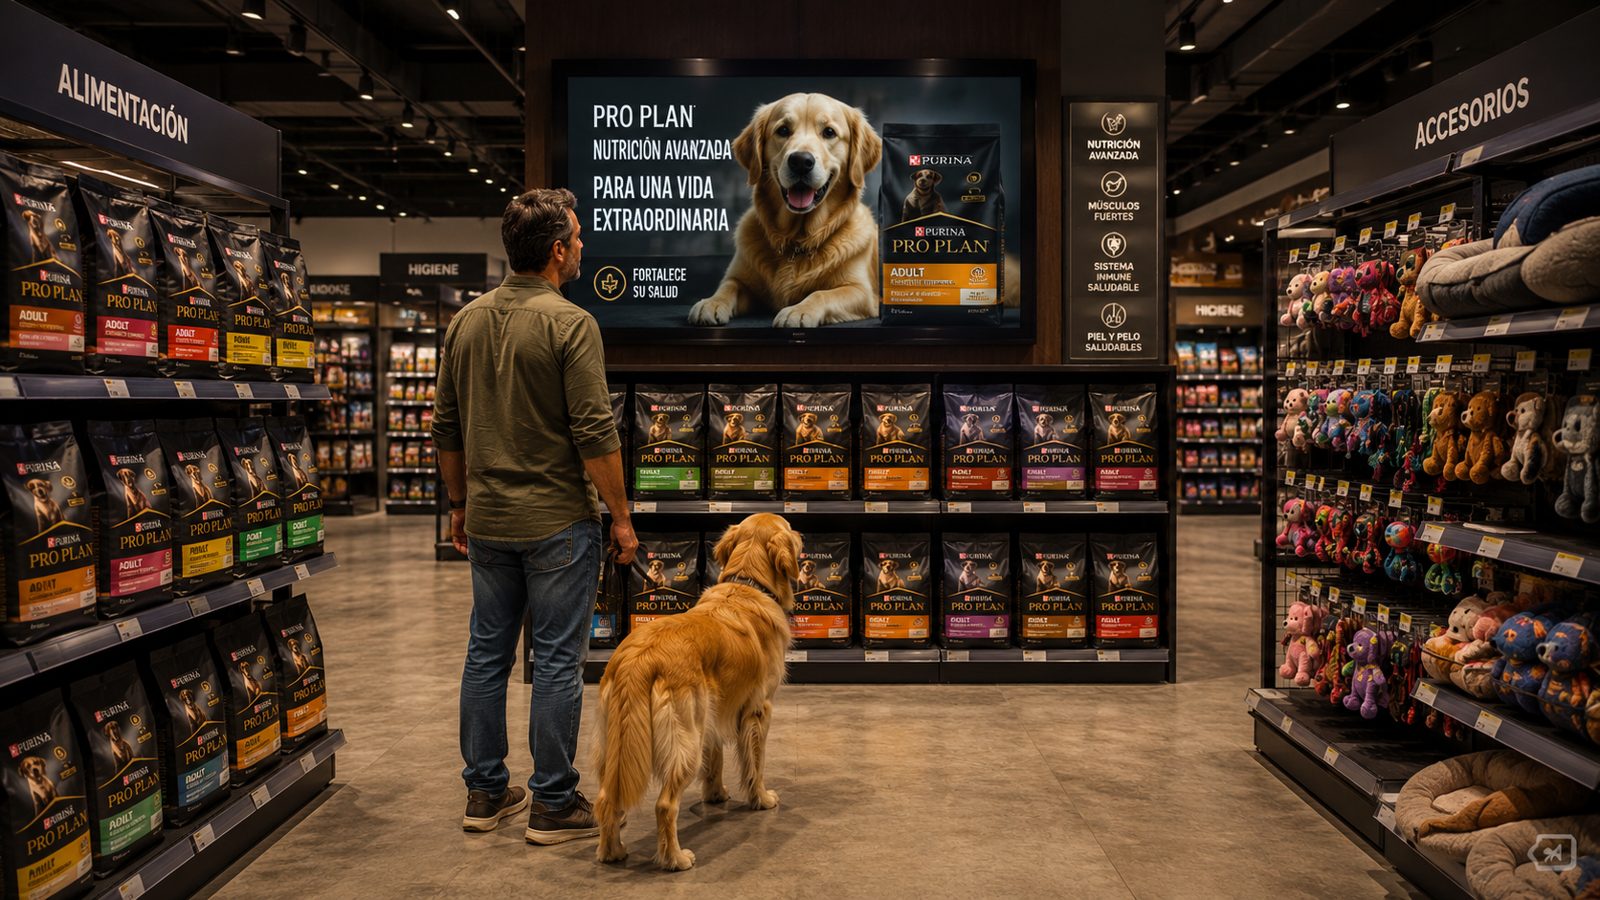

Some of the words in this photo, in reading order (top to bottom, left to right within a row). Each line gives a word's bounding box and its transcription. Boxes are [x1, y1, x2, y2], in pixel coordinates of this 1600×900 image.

[58, 63, 188, 144] ALIMENTACIÓN
[593, 104, 633, 128] PRO
[640, 104, 693, 128] PLAN
[1414, 76, 1529, 150] ACCESORIOS
[1087, 138, 1141, 149] NUTRICIÓN
[922, 156, 972, 165] PURINA
[1089, 151, 1139, 160] AVANZADA
[593, 175, 635, 199] PARA
[640, 175, 673, 199] UNA
[676, 175, 714, 199] VIDA
[1088, 200, 1140, 210] MÚSCULOS
[593, 208, 730, 232] EXTRAORDINARIA
[1094, 212, 1134, 220] FUERTES
[926, 227, 966, 236] PURINA
[892, 239, 930, 254] PRO
[934, 239, 989, 254] PLAN
[408, 263, 459, 276] HIGIENE
[890, 267, 925, 277] ADULT
[1094, 262, 1134, 271] SISTEMA
[633, 268, 687, 282] FORTALECE
[1096, 272, 1132, 282] INMUNE
[21, 280, 51, 298] PRO
[53, 285, 83, 303] PLAN
[633, 286, 646, 298] SU
[648, 286, 678, 298] SALUD
[1087, 283, 1140, 292] SALUDABLE
[106, 294, 131, 310] PRO
[20, 310, 48, 322] ADULT
[176, 304, 196, 319] PRO
[234, 314, 252, 327] PRO
[1088, 332, 1106, 341] PIEL
[1108, 332, 1115, 341] Y
[1117, 332, 1140, 341] PELO
[1085, 343, 1142, 352] SALUDABLES
[641, 454, 662, 463] PRO
[665, 454, 696, 463] PLAN
[716, 454, 737, 463] PRO
[740, 454, 770, 463] PLAN
[790, 454, 812, 463] PRO
[814, 454, 844, 463] PLAN
[870, 454, 892, 463] PRO
[894, 454, 924, 463] PLAN
[952, 454, 974, 463] PRO
[977, 454, 1007, 463] PLAN
[1028, 454, 1049, 463] PRO
[1052, 454, 1081, 463] PLAN
[1100, 454, 1122, 463] PRO
[1126, 454, 1153, 463] PLAN
[293, 500, 309, 514] PRO
[247, 512, 264, 524] PRO
[190, 522, 211, 537] PRO
[120, 534, 145, 550] PRO
[146, 528, 172, 545] PLAN
[30, 550, 59, 568] PRO
[61, 542, 94, 562] PLAN
[636, 602, 658, 610] PRO
[660, 602, 690, 610] PLAN
[791, 602, 811, 610] PRO
[814, 602, 844, 610] PLAN
[870, 602, 892, 610] PRO
[894, 602, 924, 610] PLAN
[952, 602, 972, 610] PRO
[976, 602, 1005, 610] PLAN
[1028, 602, 1050, 610] PRO
[1053, 602, 1082, 610] PLAN
[1100, 602, 1122, 610] PRO
[1125, 602, 1154, 610] PLAN
[293, 687, 310, 704] PRO
[244, 716, 262, 732] PRO
[185, 746, 206, 766] PRO
[108, 786, 133, 809] PRO
[134, 772, 160, 796] PLAN
[27, 830, 56, 857] PRO
[56, 809, 88, 841] PLAN
